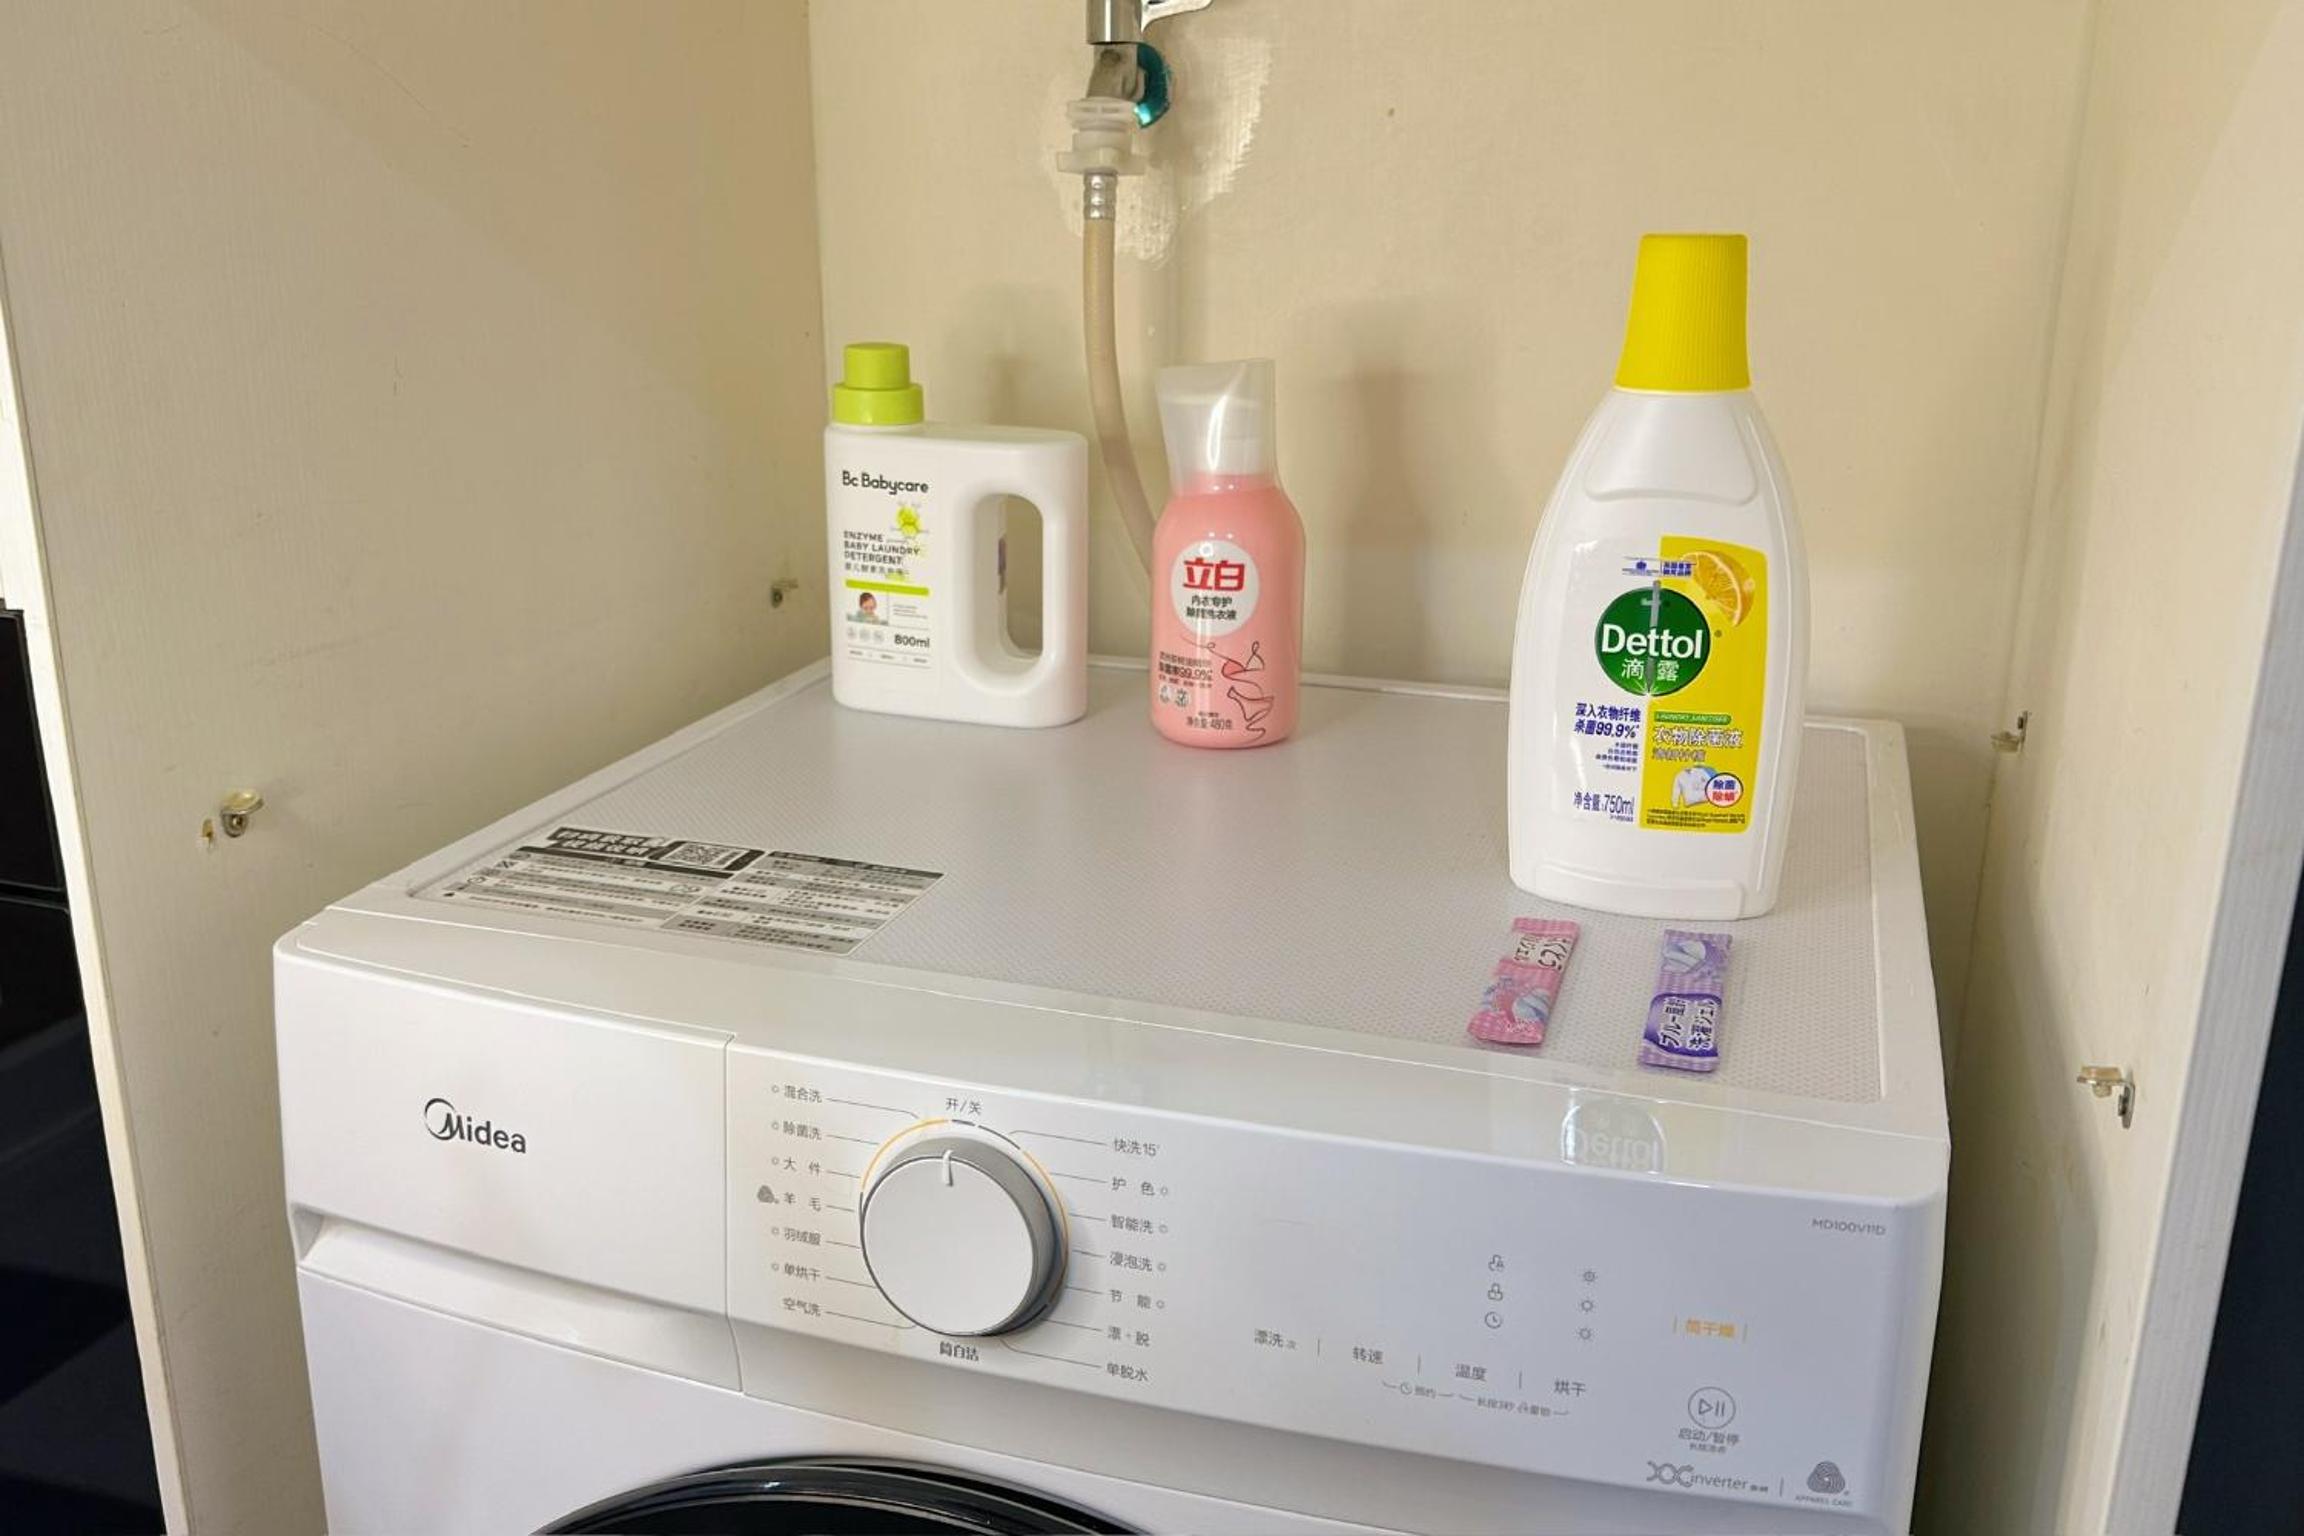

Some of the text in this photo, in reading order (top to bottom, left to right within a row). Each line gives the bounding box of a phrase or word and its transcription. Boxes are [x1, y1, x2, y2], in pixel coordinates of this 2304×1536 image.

[842, 471, 930, 495] Bc Babycare
[844, 531, 884, 543] ENZYME
[844, 540, 921, 557] BABY LAUNDRY
[844, 551, 902, 565] DETERGENT
[1183, 557, 1246, 591] 立白
[894, 634, 930, 649] 800ml
[1601, 624, 1703, 659] Dettol
[1621, 658, 1680, 682] 滴露
[1575, 702, 1641, 723] 深入衣物纤维
[1652, 725, 1745, 748] 衣物除菌液
[1712, 778, 1737, 791] 除菌
[784, 1085, 823, 1104] 混合洗
[945, 1097, 982, 1115] 开/关
[424, 1098, 526, 1153] Midea
[783, 1121, 822, 1141] 除菌洗
[1111, 1214, 1154, 1235] 智能洗
[784, 1227, 821, 1247] 羽绒服
[1109, 1251, 1154, 1273] 浸泡洗
[784, 1263, 821, 1282] 单烘干
[783, 1297, 822, 1318] 空气洗
[1352, 1346, 1384, 1365] 转速
[1107, 1363, 1149, 1383] 单脱水
[1455, 1363, 1488, 1383] 温度
[1554, 1379, 1587, 1399] 烘干
[1678, 1427, 1740, 1446] 启动/暂停
